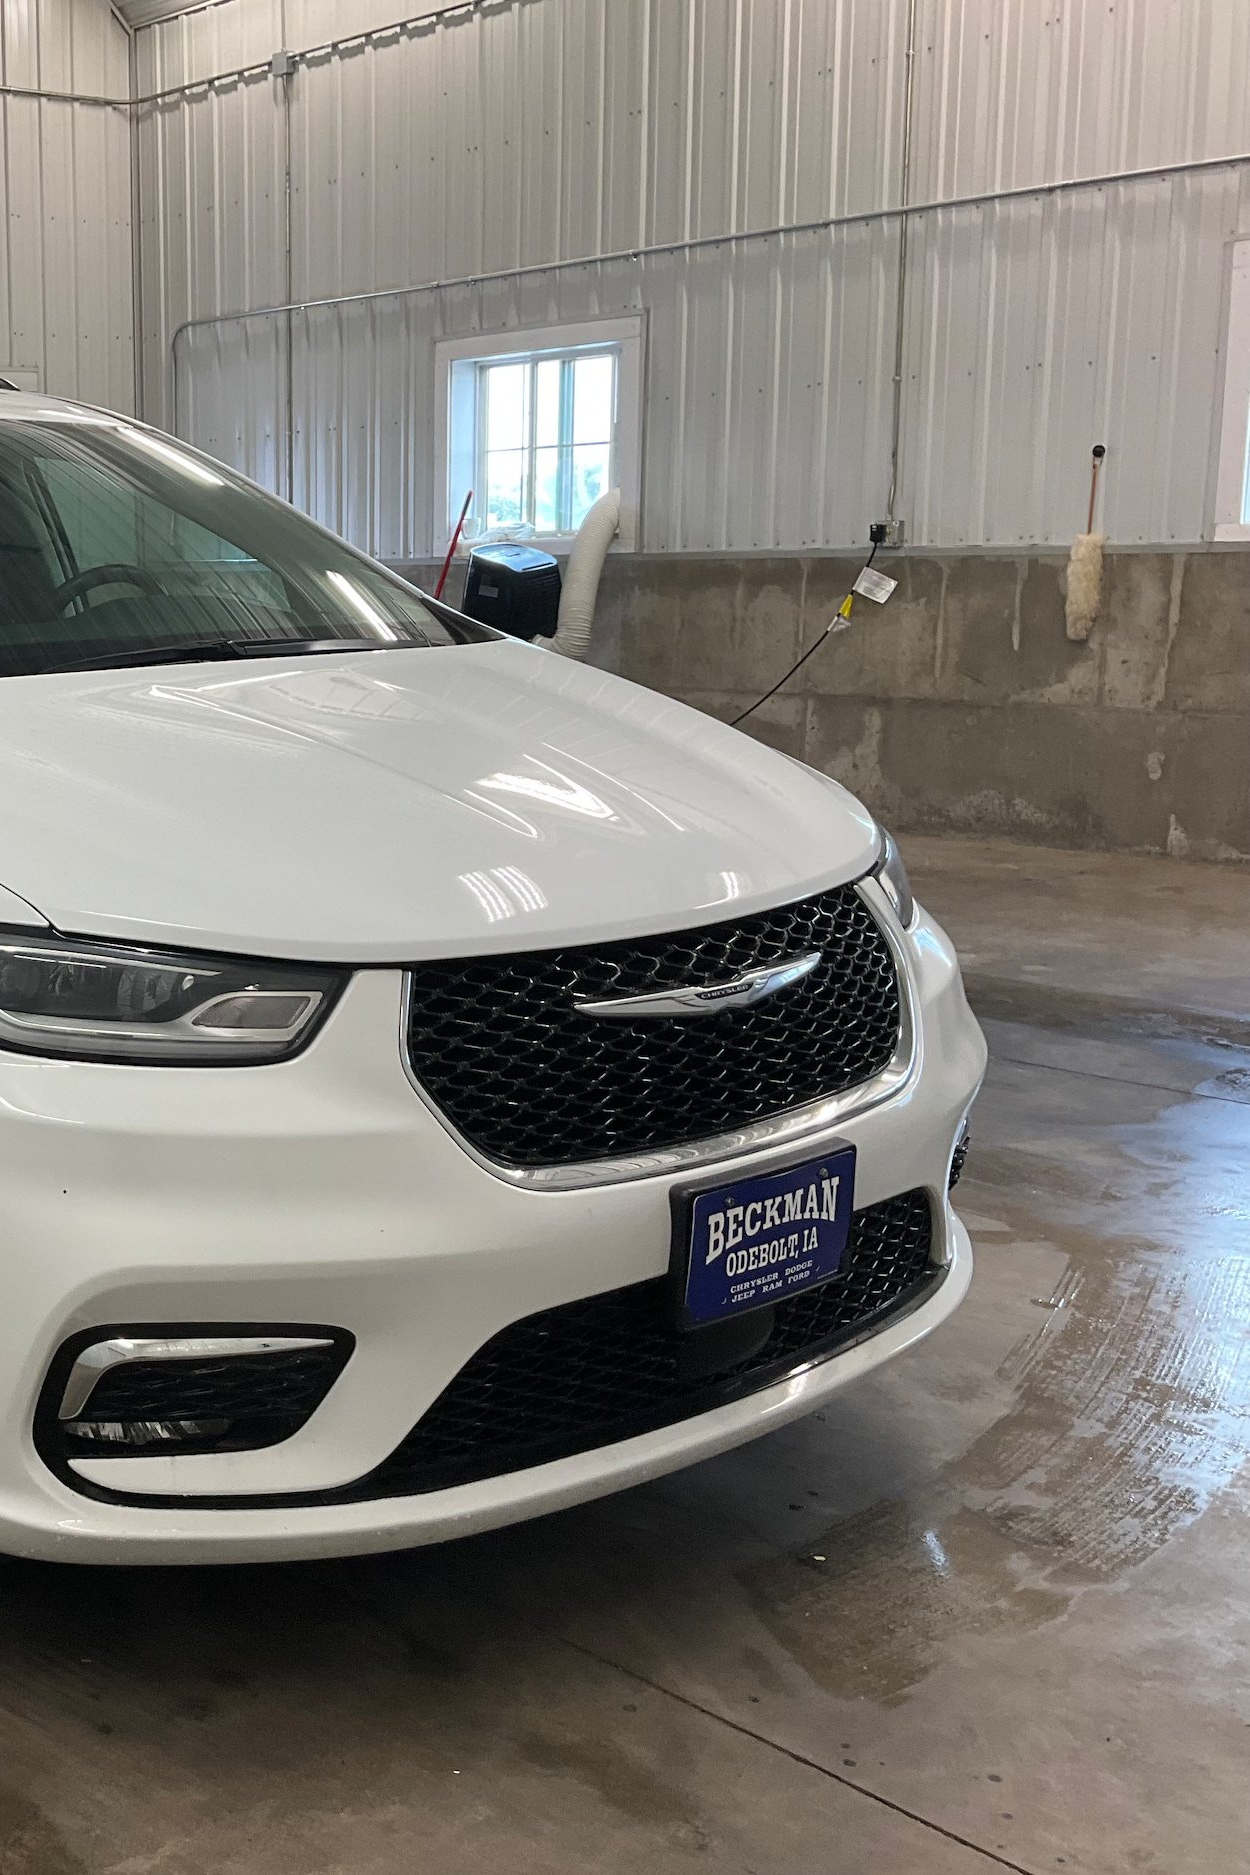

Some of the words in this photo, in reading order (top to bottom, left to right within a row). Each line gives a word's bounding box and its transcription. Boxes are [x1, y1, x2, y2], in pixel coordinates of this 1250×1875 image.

[701, 984, 749, 999] CHRYSLER
[706, 1176, 840, 1265] BECKMAN
[726, 1233, 798, 1277] ODEBOLT,
[802, 1226, 819, 1253] IA
[730, 1272, 779, 1294] CHRYSLER
[785, 1260, 813, 1275] DODGE
[731, 1289, 755, 1303] JEEP
[762, 1280, 783, 1293] RAM
[788, 1270, 810, 1284] FORD
